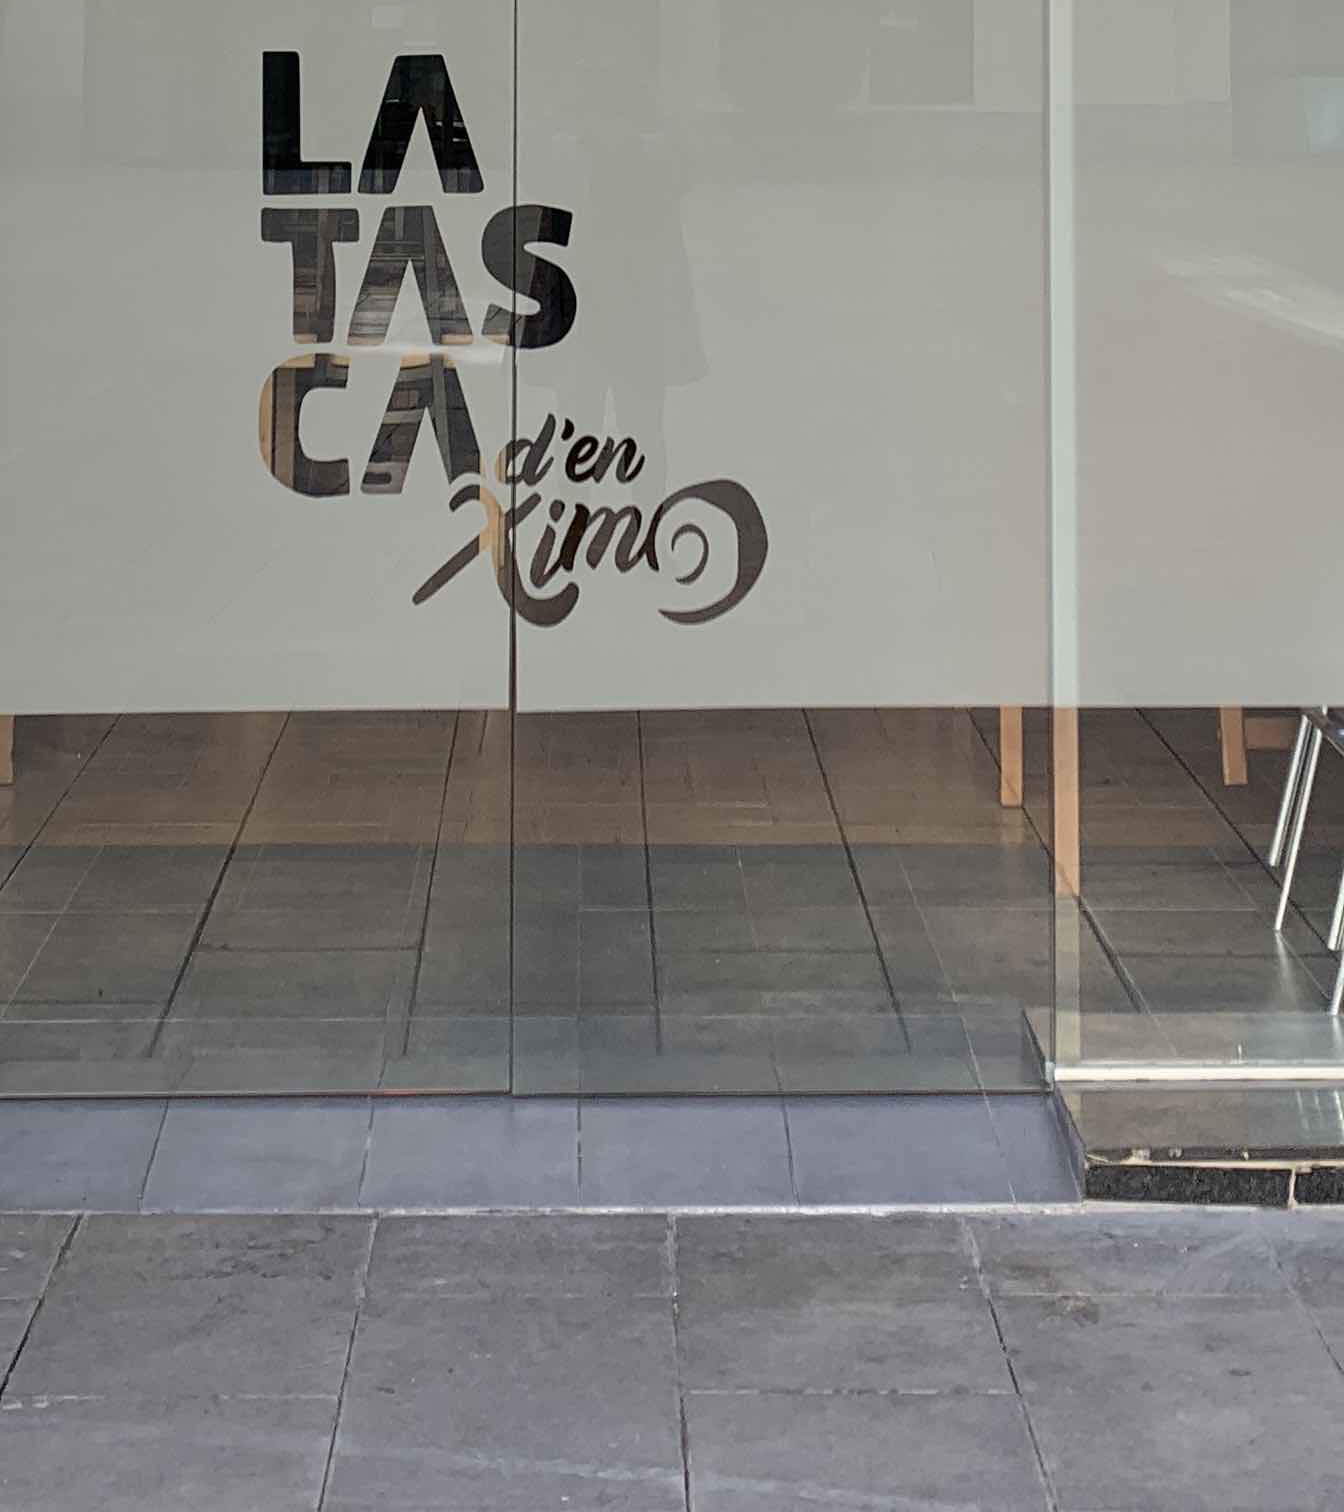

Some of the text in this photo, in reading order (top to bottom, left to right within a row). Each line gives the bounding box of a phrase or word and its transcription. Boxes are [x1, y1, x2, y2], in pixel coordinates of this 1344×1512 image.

[262, 51, 484, 194] LA
[260, 204, 577, 349] TAS
[258, 352, 482, 498] CA
